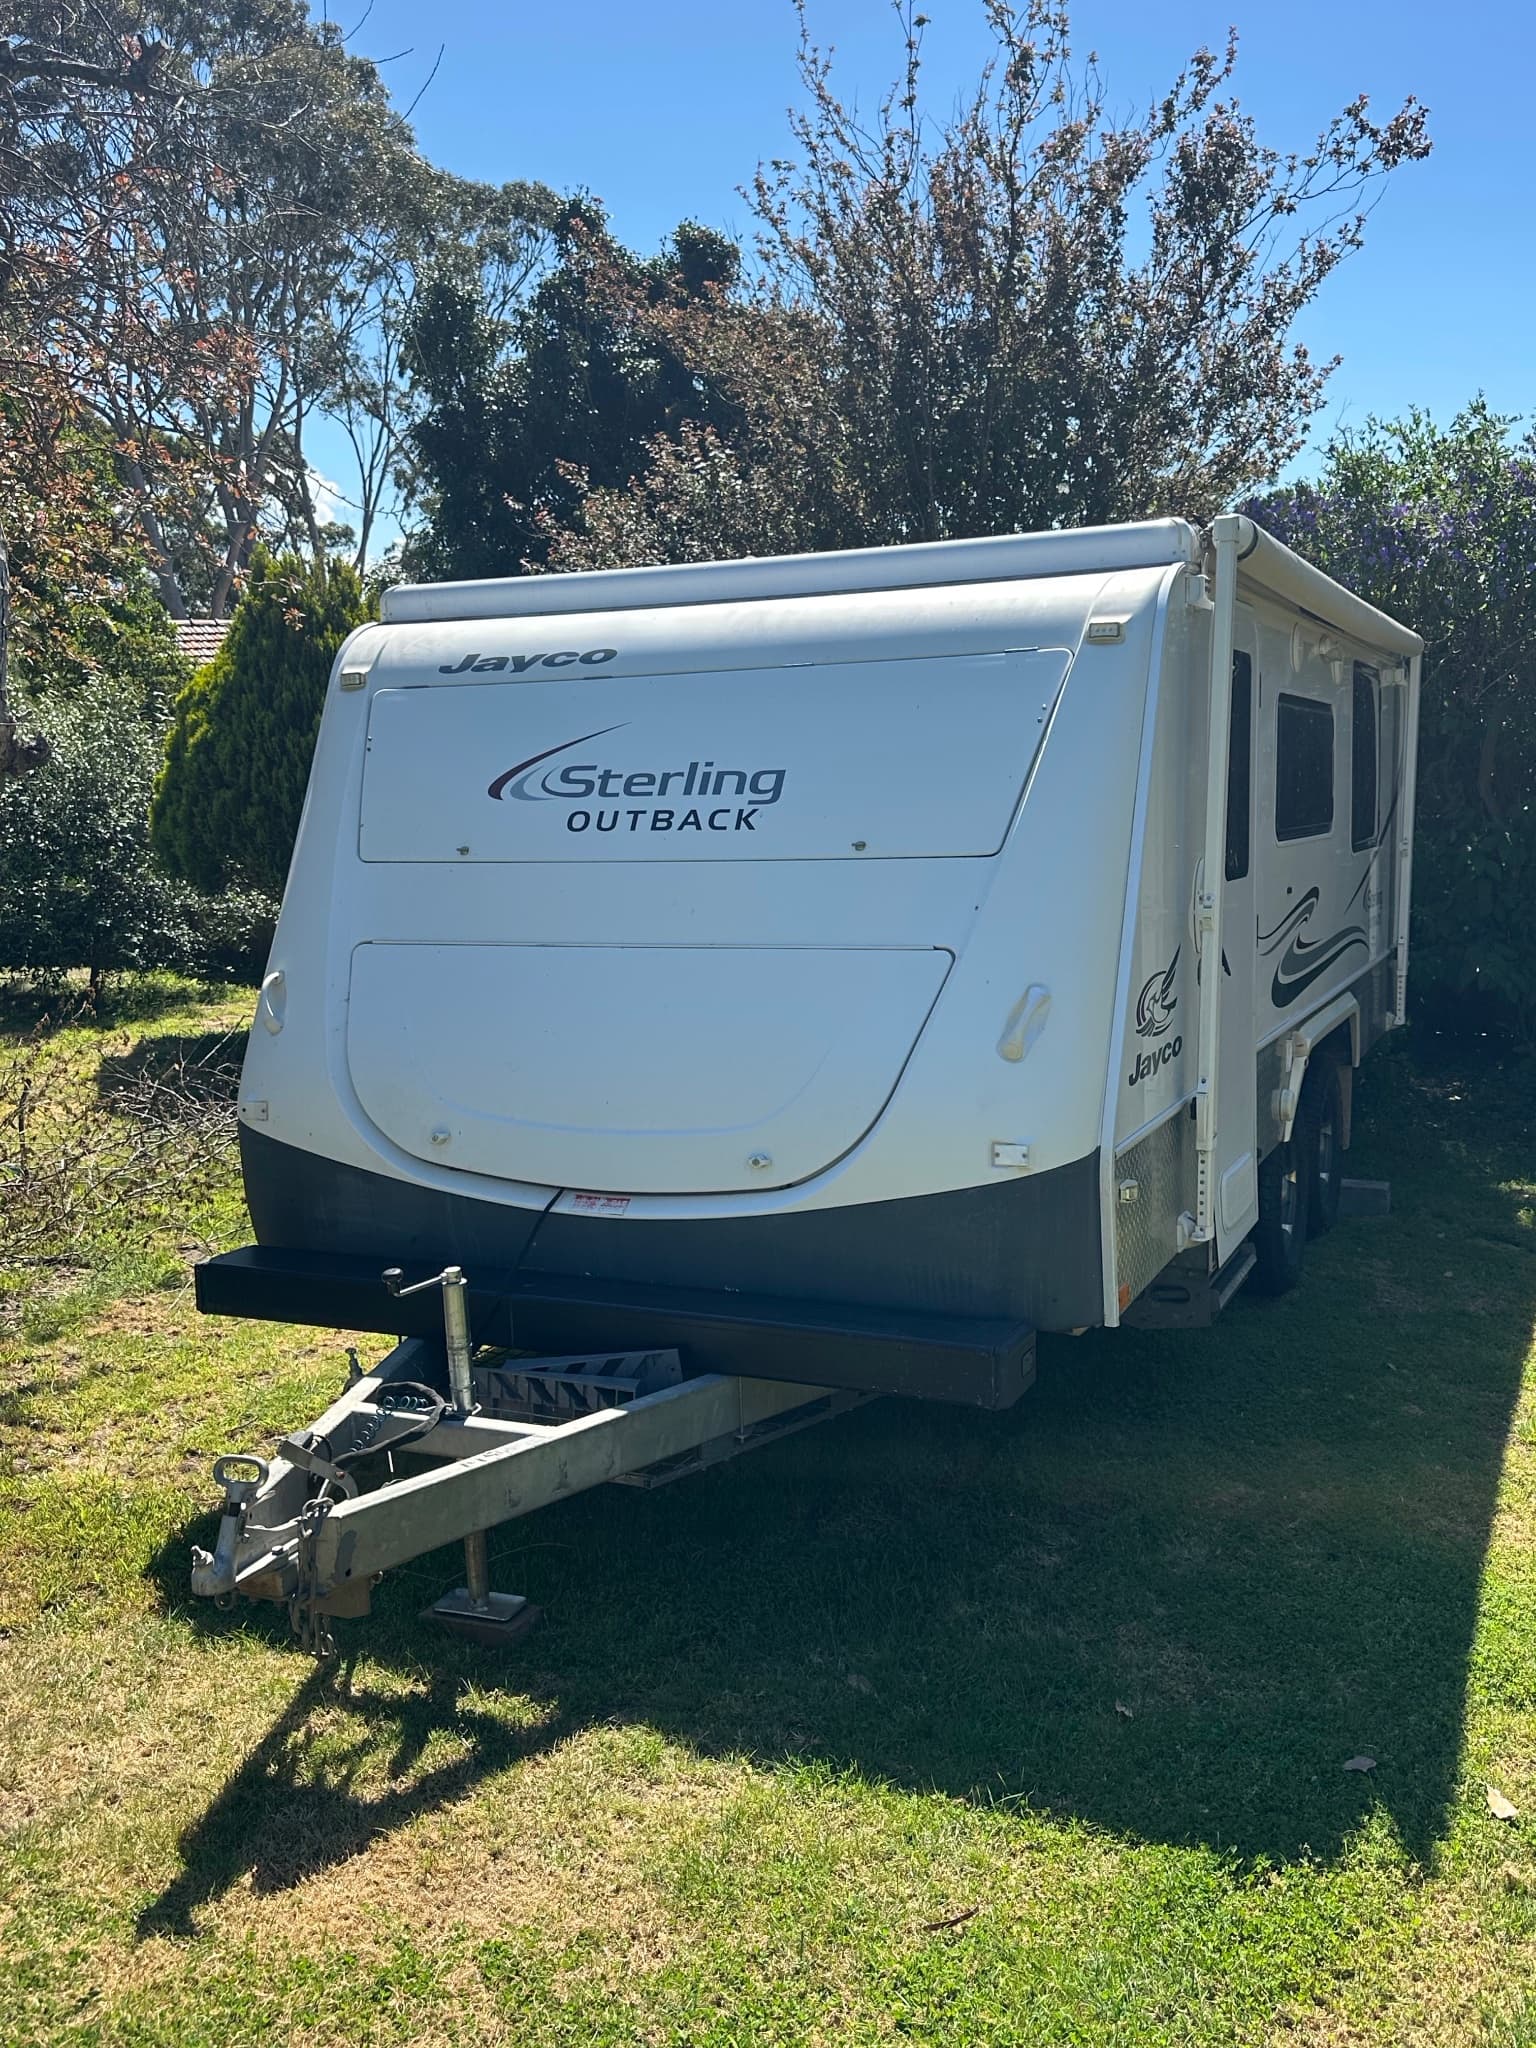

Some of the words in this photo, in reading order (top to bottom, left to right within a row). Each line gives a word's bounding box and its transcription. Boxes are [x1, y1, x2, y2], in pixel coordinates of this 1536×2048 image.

[438, 648, 618, 674] Jayco
[542, 761, 786, 805] Sterling
[566, 808, 759, 832] OUTBACK
[1128, 1035, 1183, 1087] Jayco
